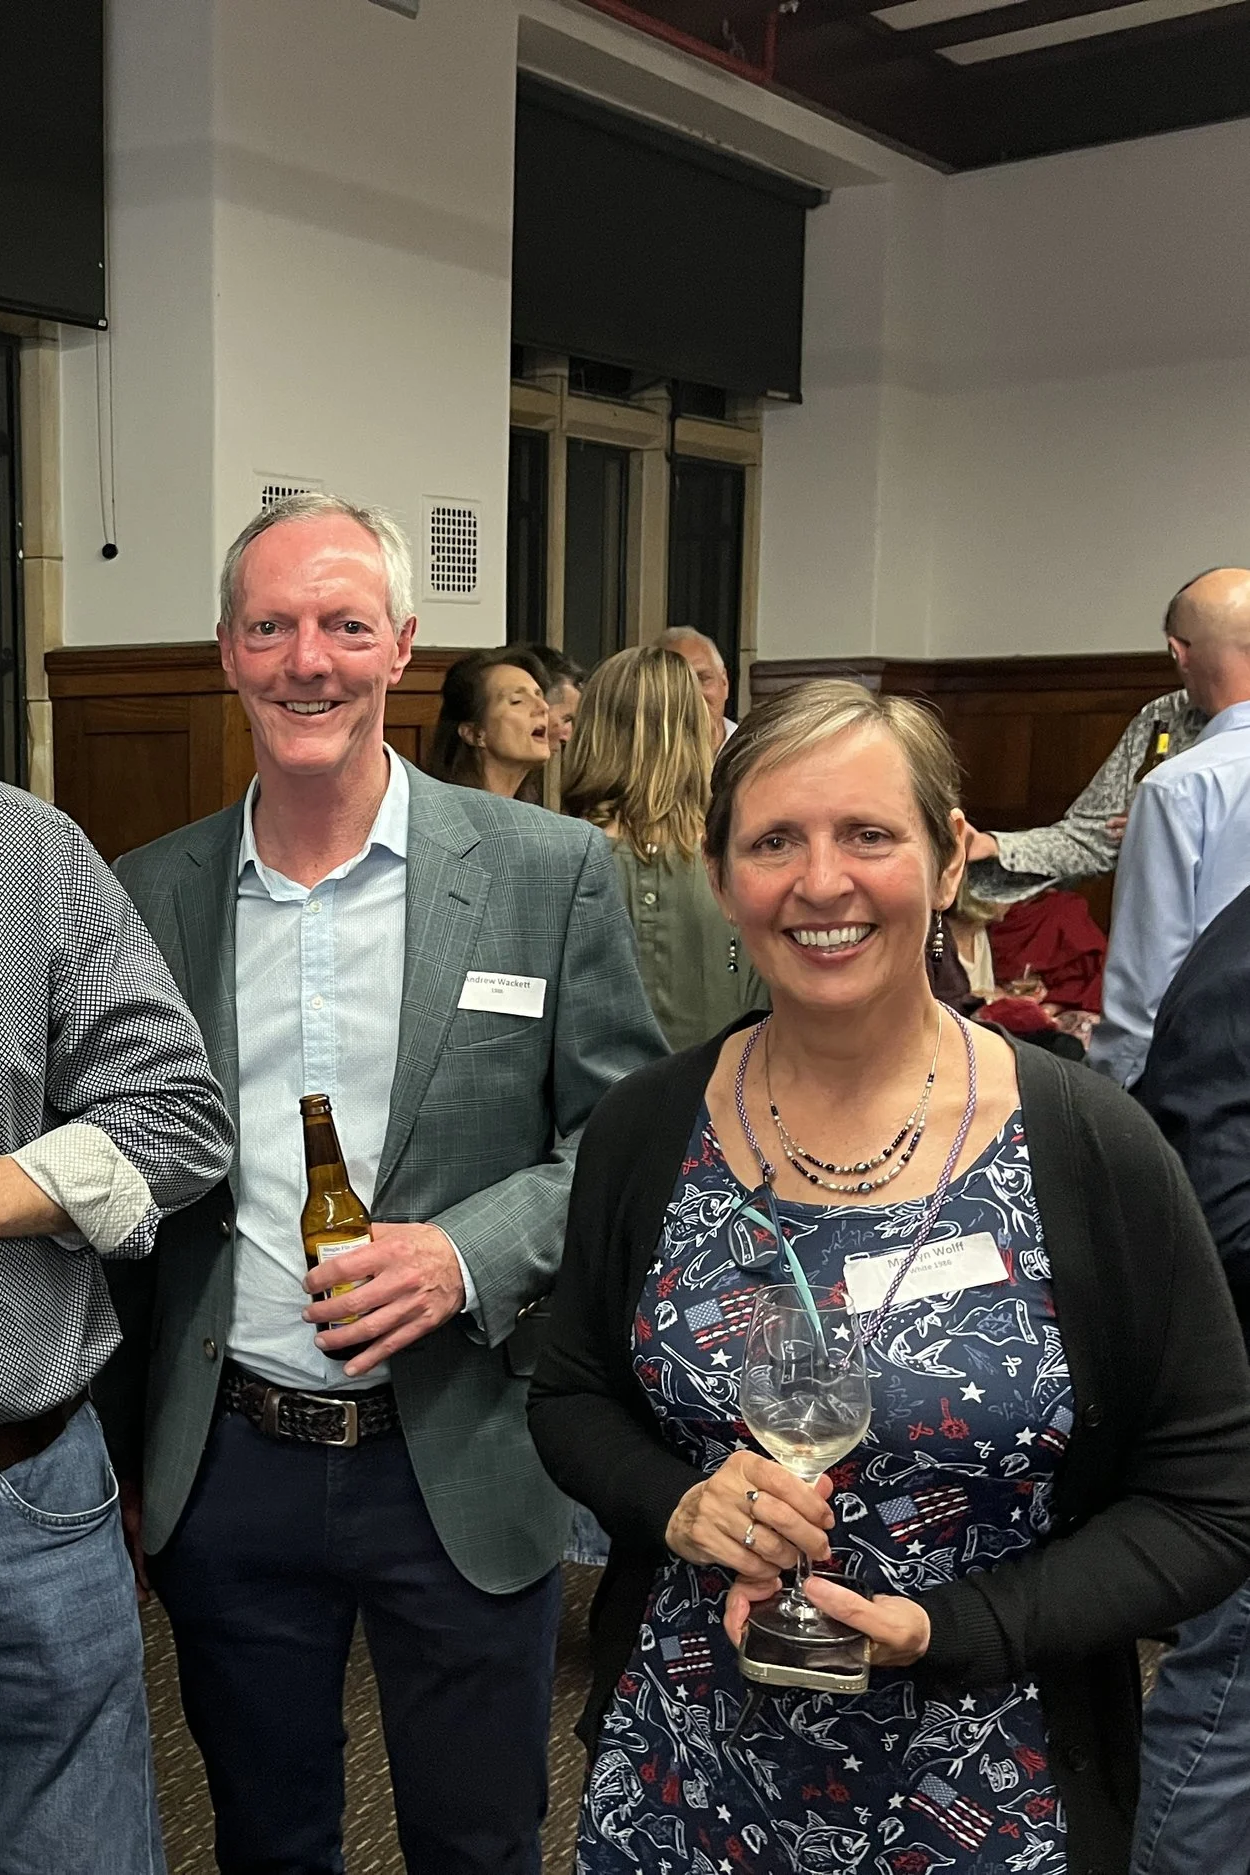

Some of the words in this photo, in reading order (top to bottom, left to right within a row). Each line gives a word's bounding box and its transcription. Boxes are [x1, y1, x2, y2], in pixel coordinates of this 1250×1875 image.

[465, 976, 496, 984] Andrew
[497, 978, 531, 989] Wackett
[888, 1252, 931, 1269] Mayn
[932, 1242, 965, 1256] Wolff
[909, 1264, 932, 1274] White
